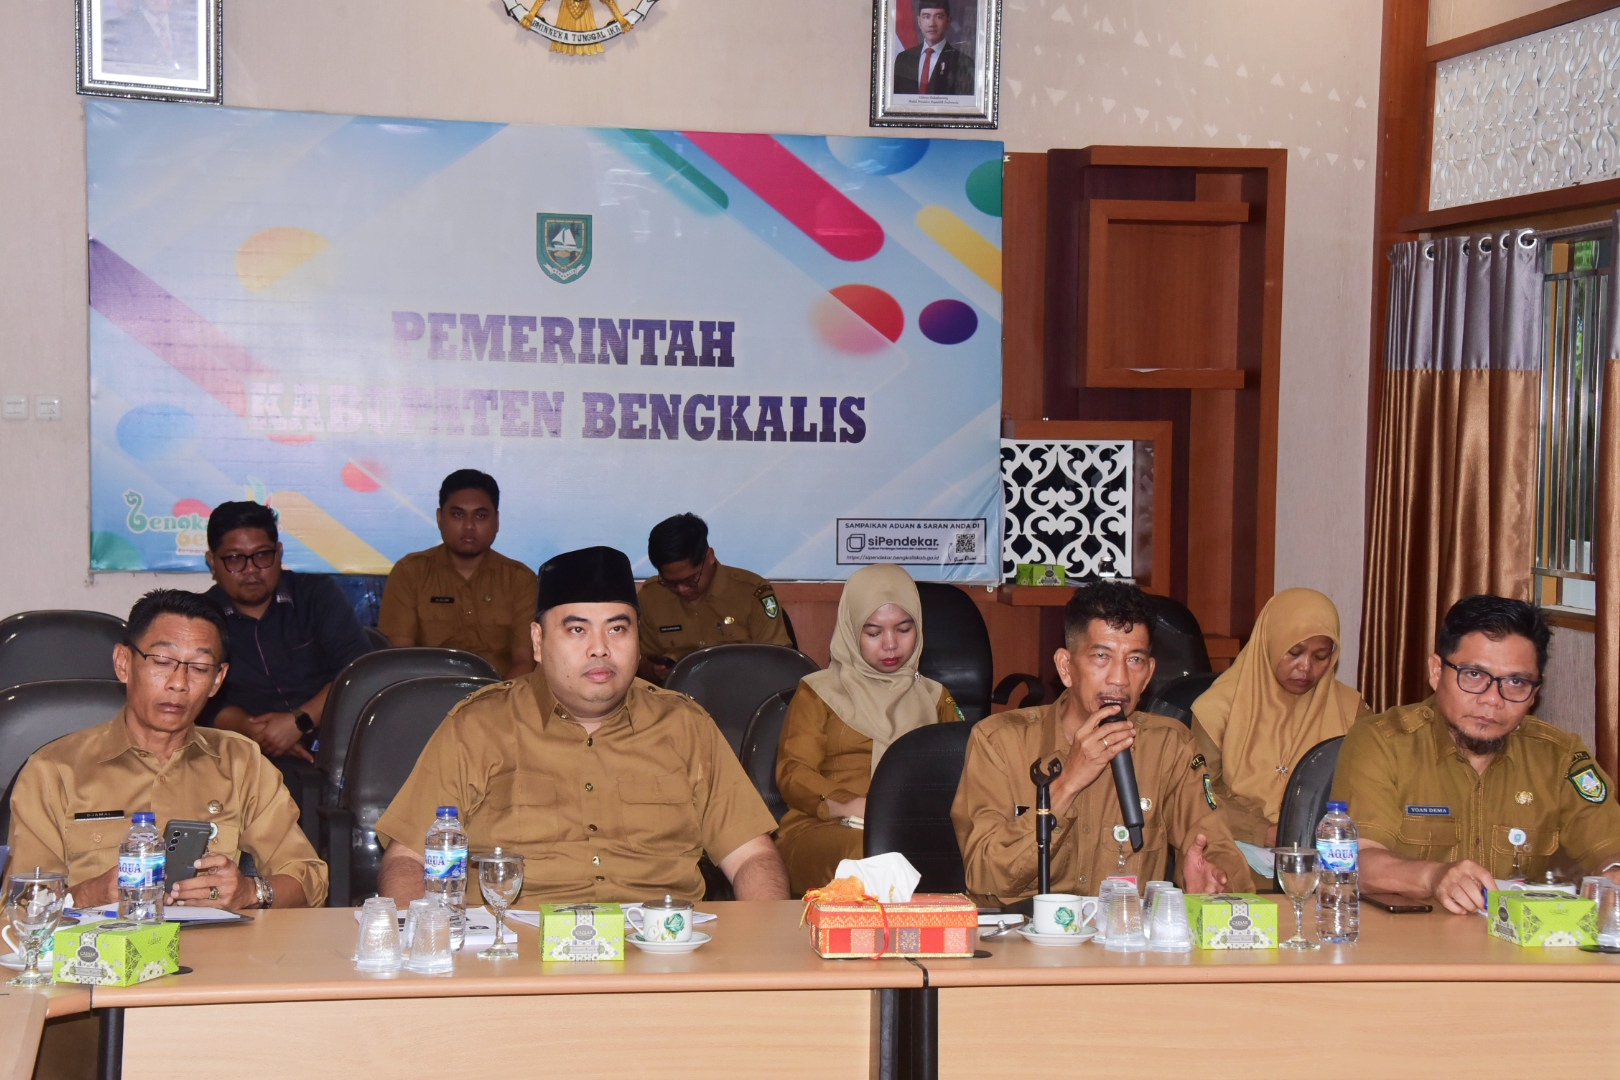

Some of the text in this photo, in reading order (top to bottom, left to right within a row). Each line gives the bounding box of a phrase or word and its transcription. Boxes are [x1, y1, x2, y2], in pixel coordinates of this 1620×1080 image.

[572, 31, 606, 42] TUNGGAL
[608, 24, 621, 36] IKA
[391, 311, 735, 368] PEMERINTAH
[246, 383, 867, 444] KABUPATEN BENGKALIS
[1327, 848, 1354, 860] AQUA
